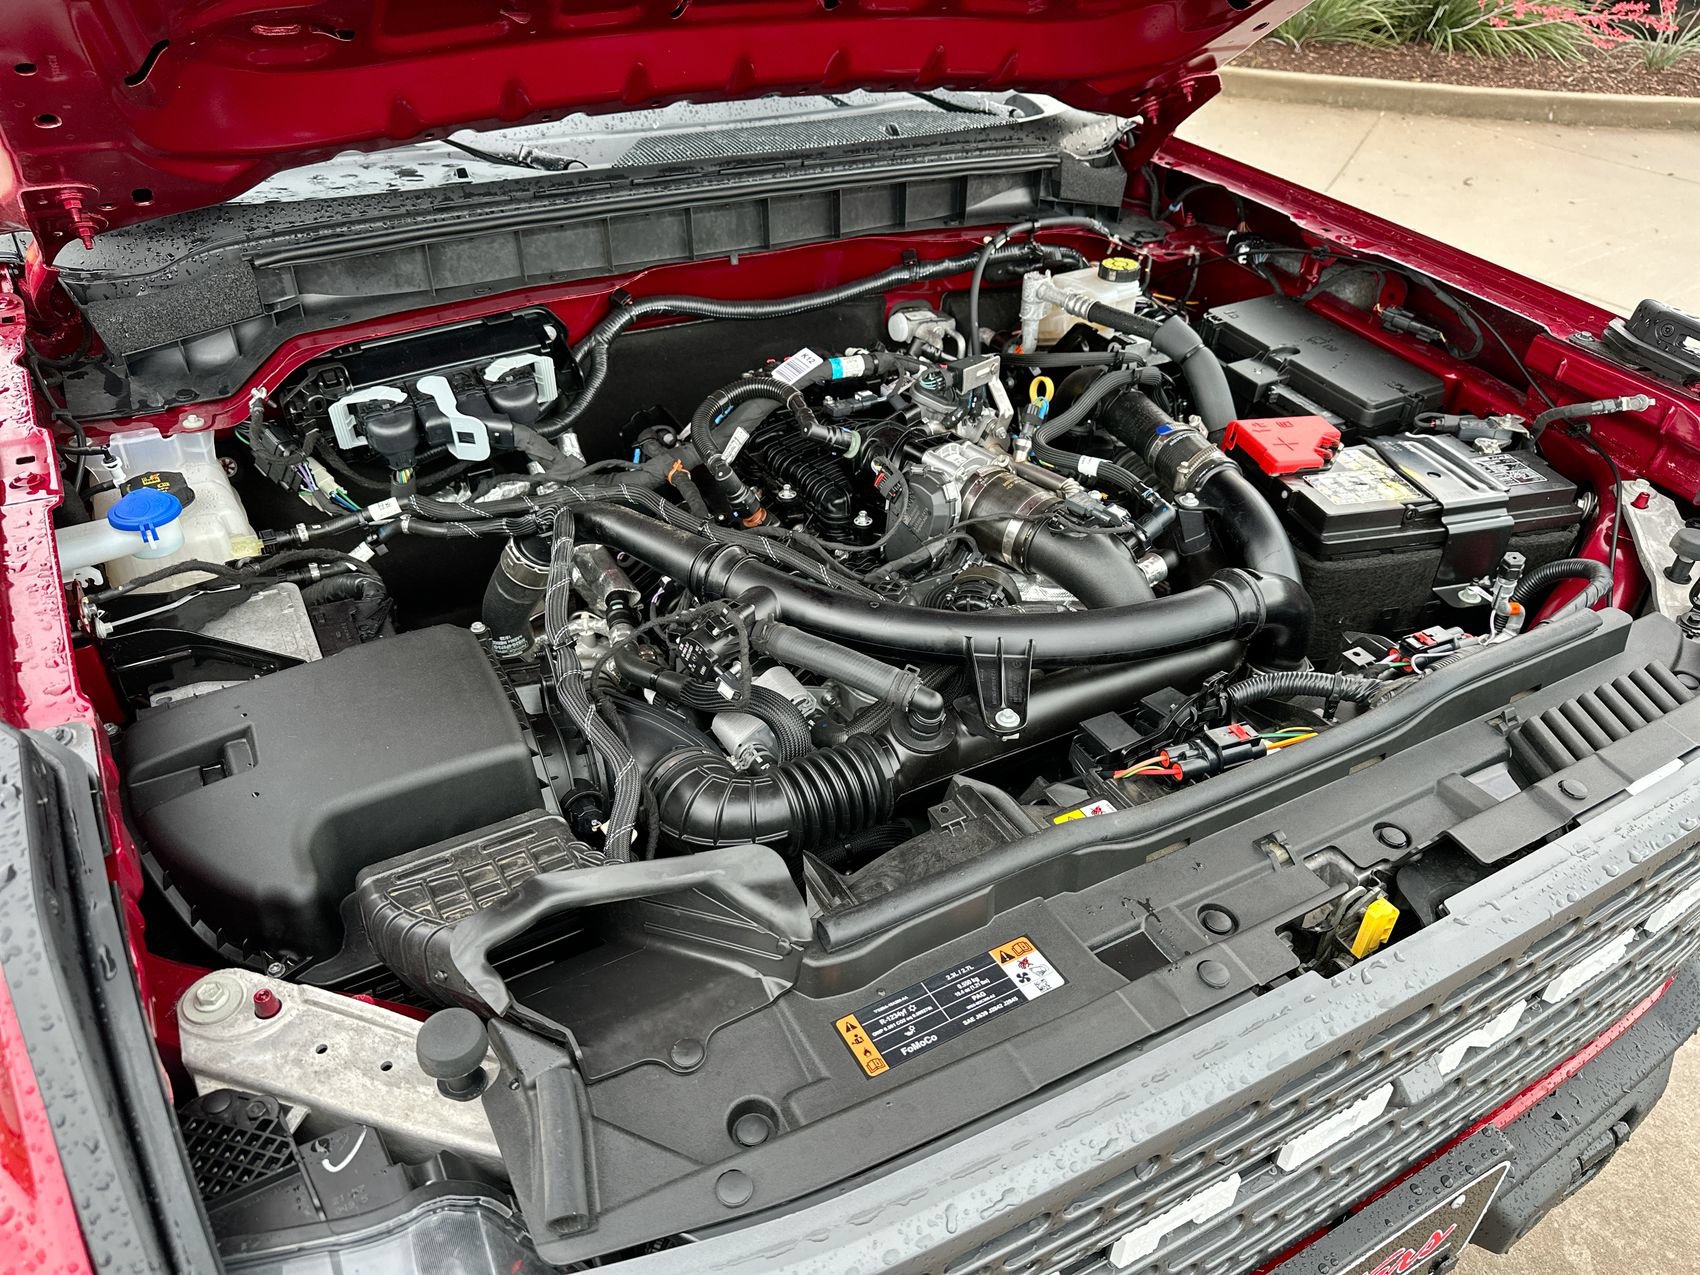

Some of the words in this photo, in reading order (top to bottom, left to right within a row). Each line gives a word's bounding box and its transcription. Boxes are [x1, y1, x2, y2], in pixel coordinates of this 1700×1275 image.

[801, 352, 816, 364] K12
[971, 991, 986, 1001] PAG
[879, 1008, 907, 1025] R-1234yf
[962, 1016, 976, 1025] SAE
[899, 1034, 938, 1056] FoMoCo
